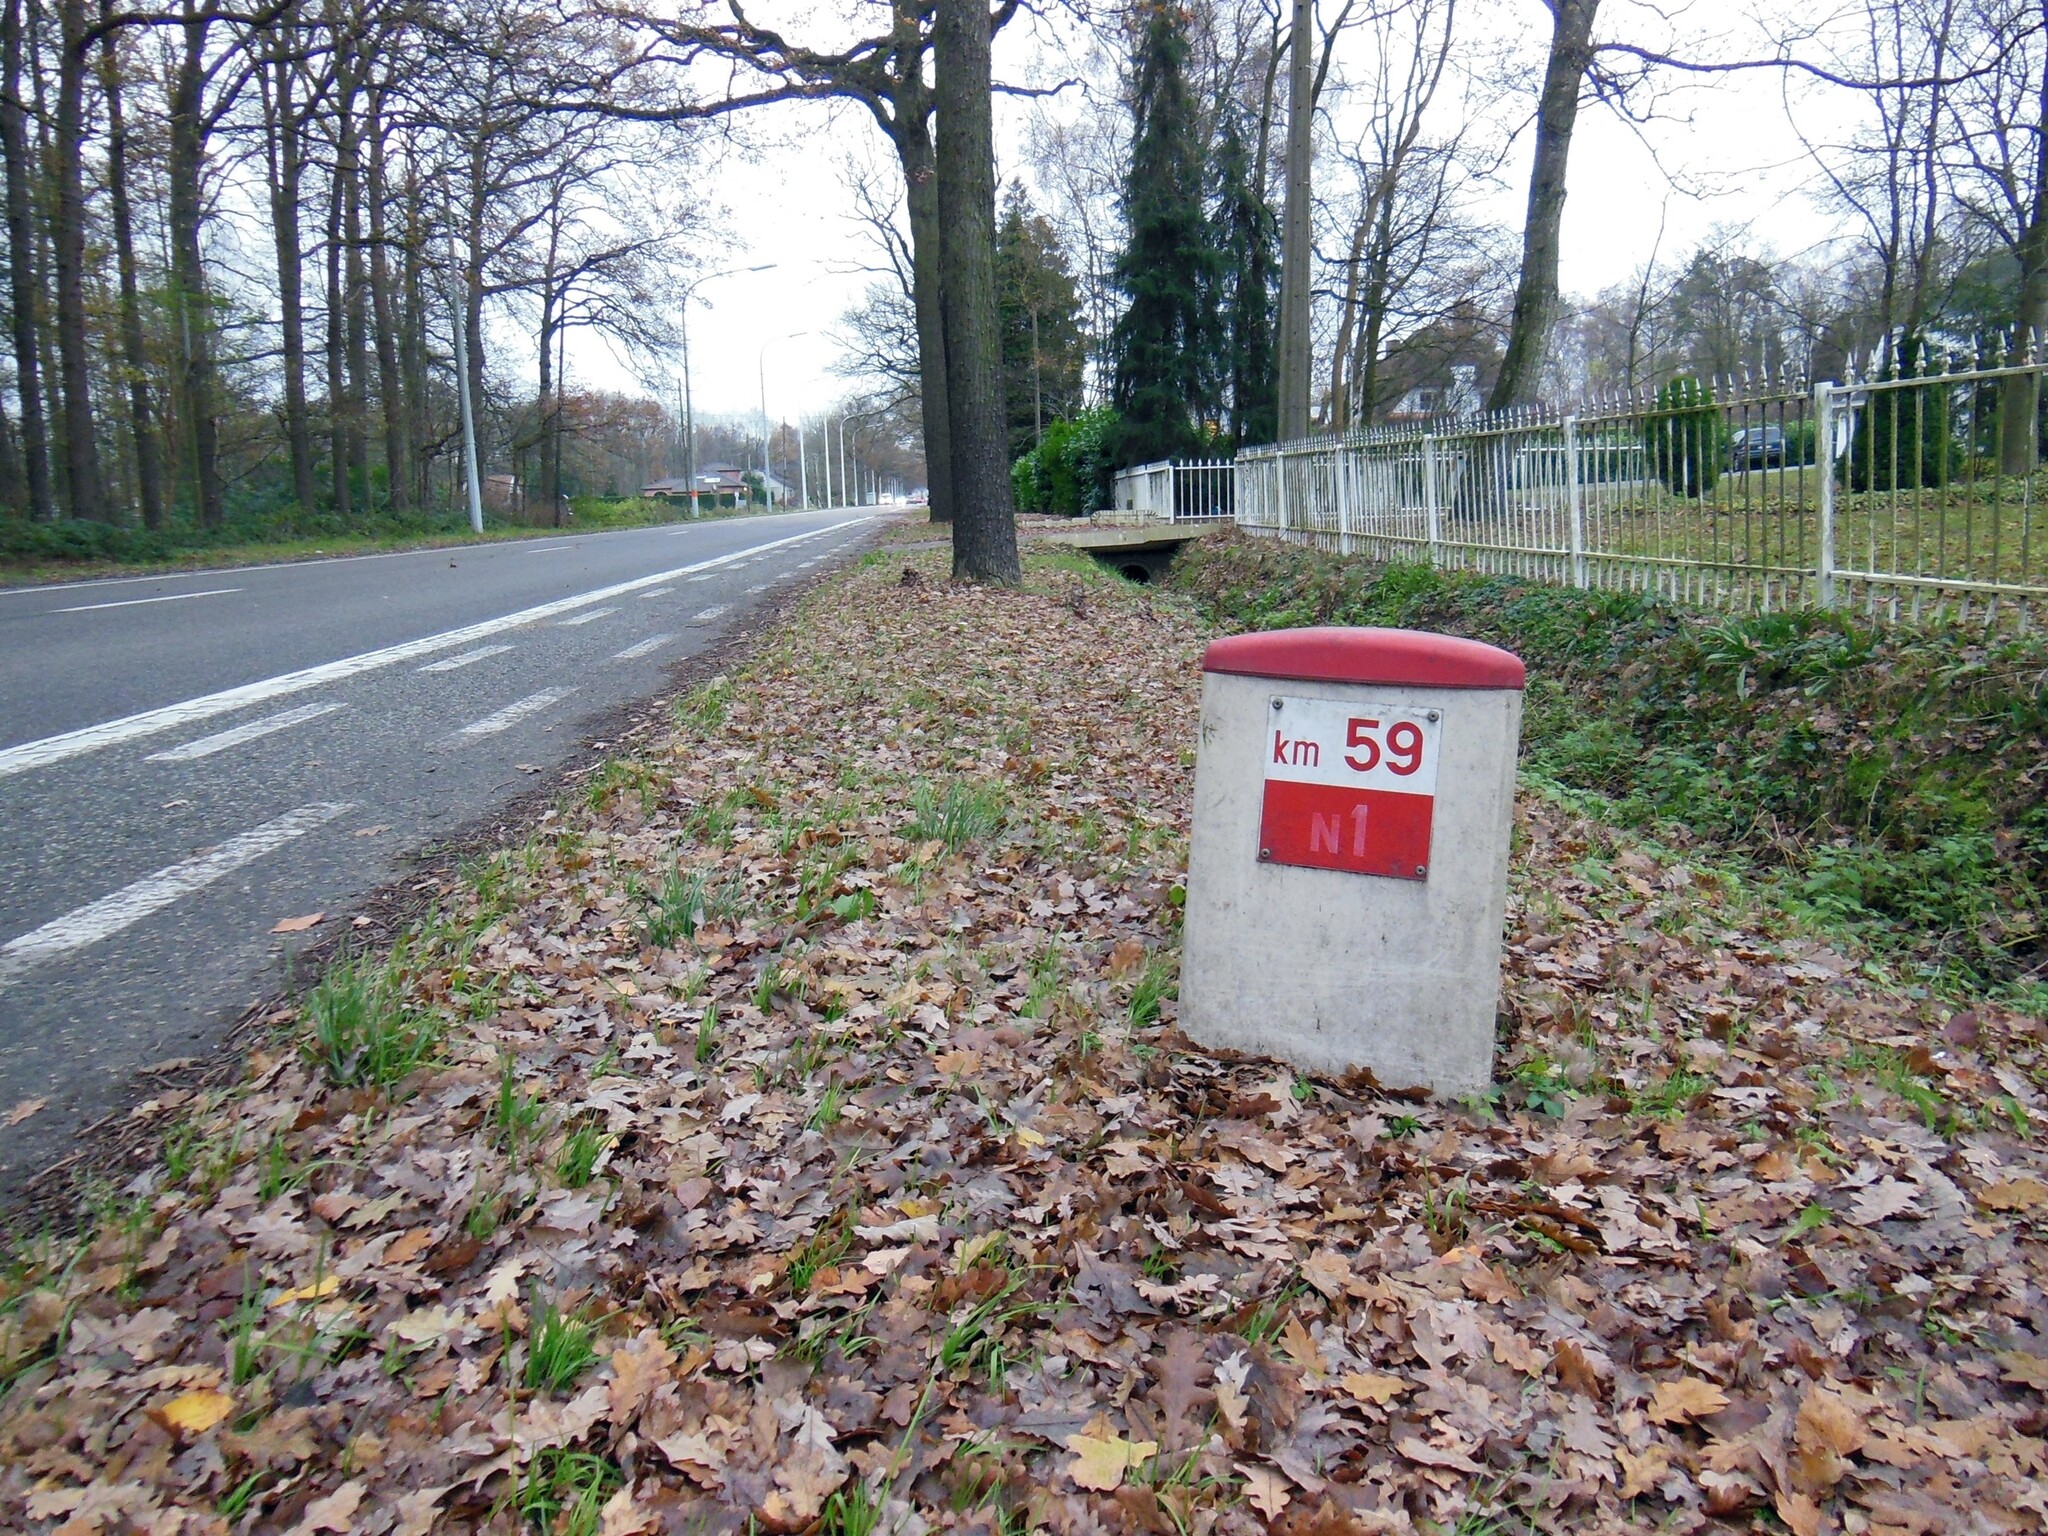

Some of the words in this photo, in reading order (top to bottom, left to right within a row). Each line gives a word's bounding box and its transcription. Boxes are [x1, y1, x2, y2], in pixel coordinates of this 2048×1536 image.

[1273, 730, 1319, 767] km
[1344, 718, 1424, 775] 59
[1310, 804, 1368, 857] N1
